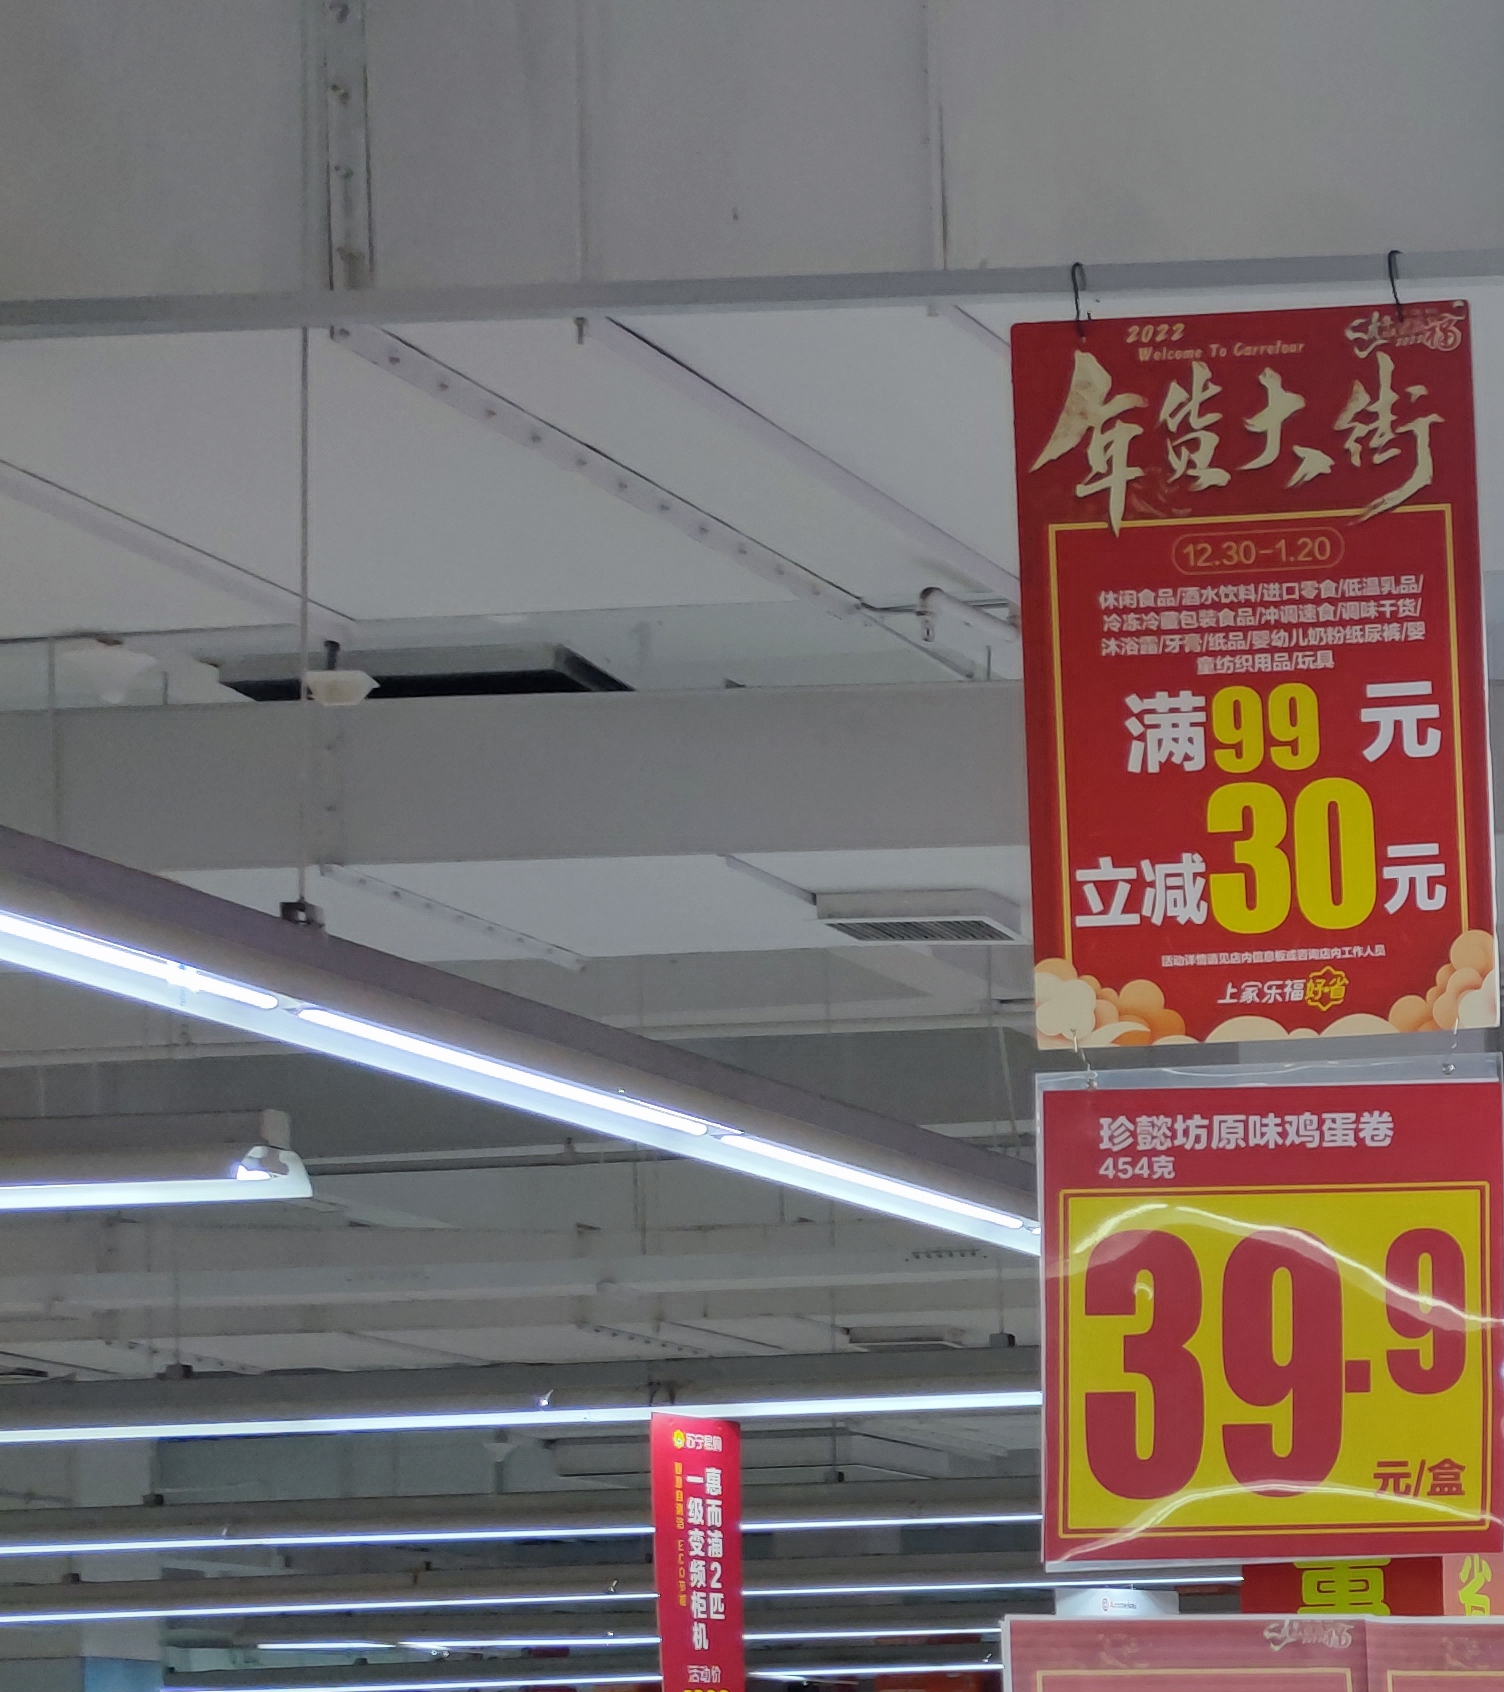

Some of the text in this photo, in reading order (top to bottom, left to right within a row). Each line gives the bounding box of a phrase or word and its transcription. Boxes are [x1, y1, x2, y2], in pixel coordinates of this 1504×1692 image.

[1126, 324, 1184, 344] 2022
[1138, 341, 1305, 361] Welcome To Carrefour
[1029, 350, 1445, 537] 年货大街
[1183, 537, 1331, 568] 12.30-1.20
[1360, 682, 1442, 762] 元
[1075, 778, 1448, 934] 立减30元
[1099, 1110, 1394, 1151] 珍懿坊原味鸡蛋卷
[1099, 1156, 1176, 1181] 454克
[1084, 1227, 1466, 1500] 39.9
[1374, 1457, 1466, 1498] 元/盒
